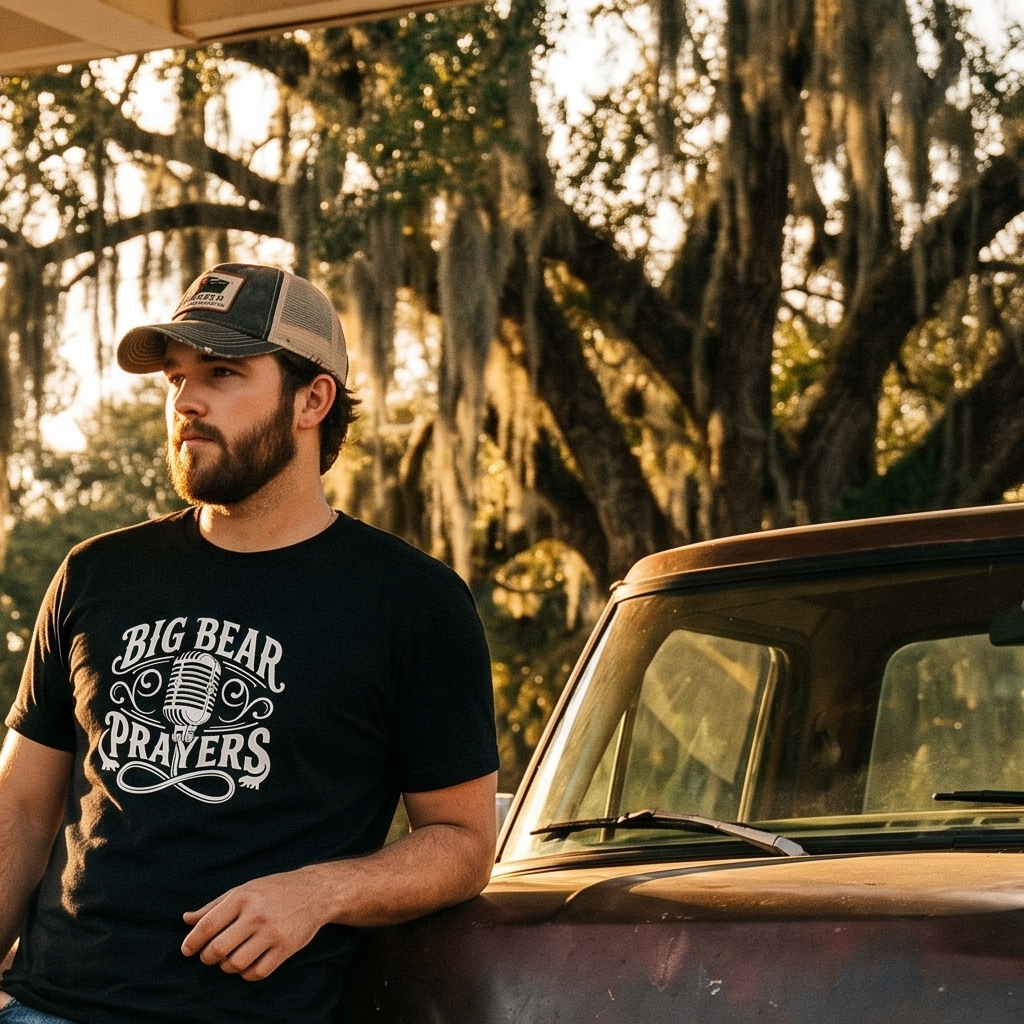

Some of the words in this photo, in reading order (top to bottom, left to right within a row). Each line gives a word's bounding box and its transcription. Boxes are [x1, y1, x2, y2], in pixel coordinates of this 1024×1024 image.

[112, 616, 188, 675] BIG
[194, 617, 286, 694] BEAR
[99, 710, 272, 782] PRAYERS
